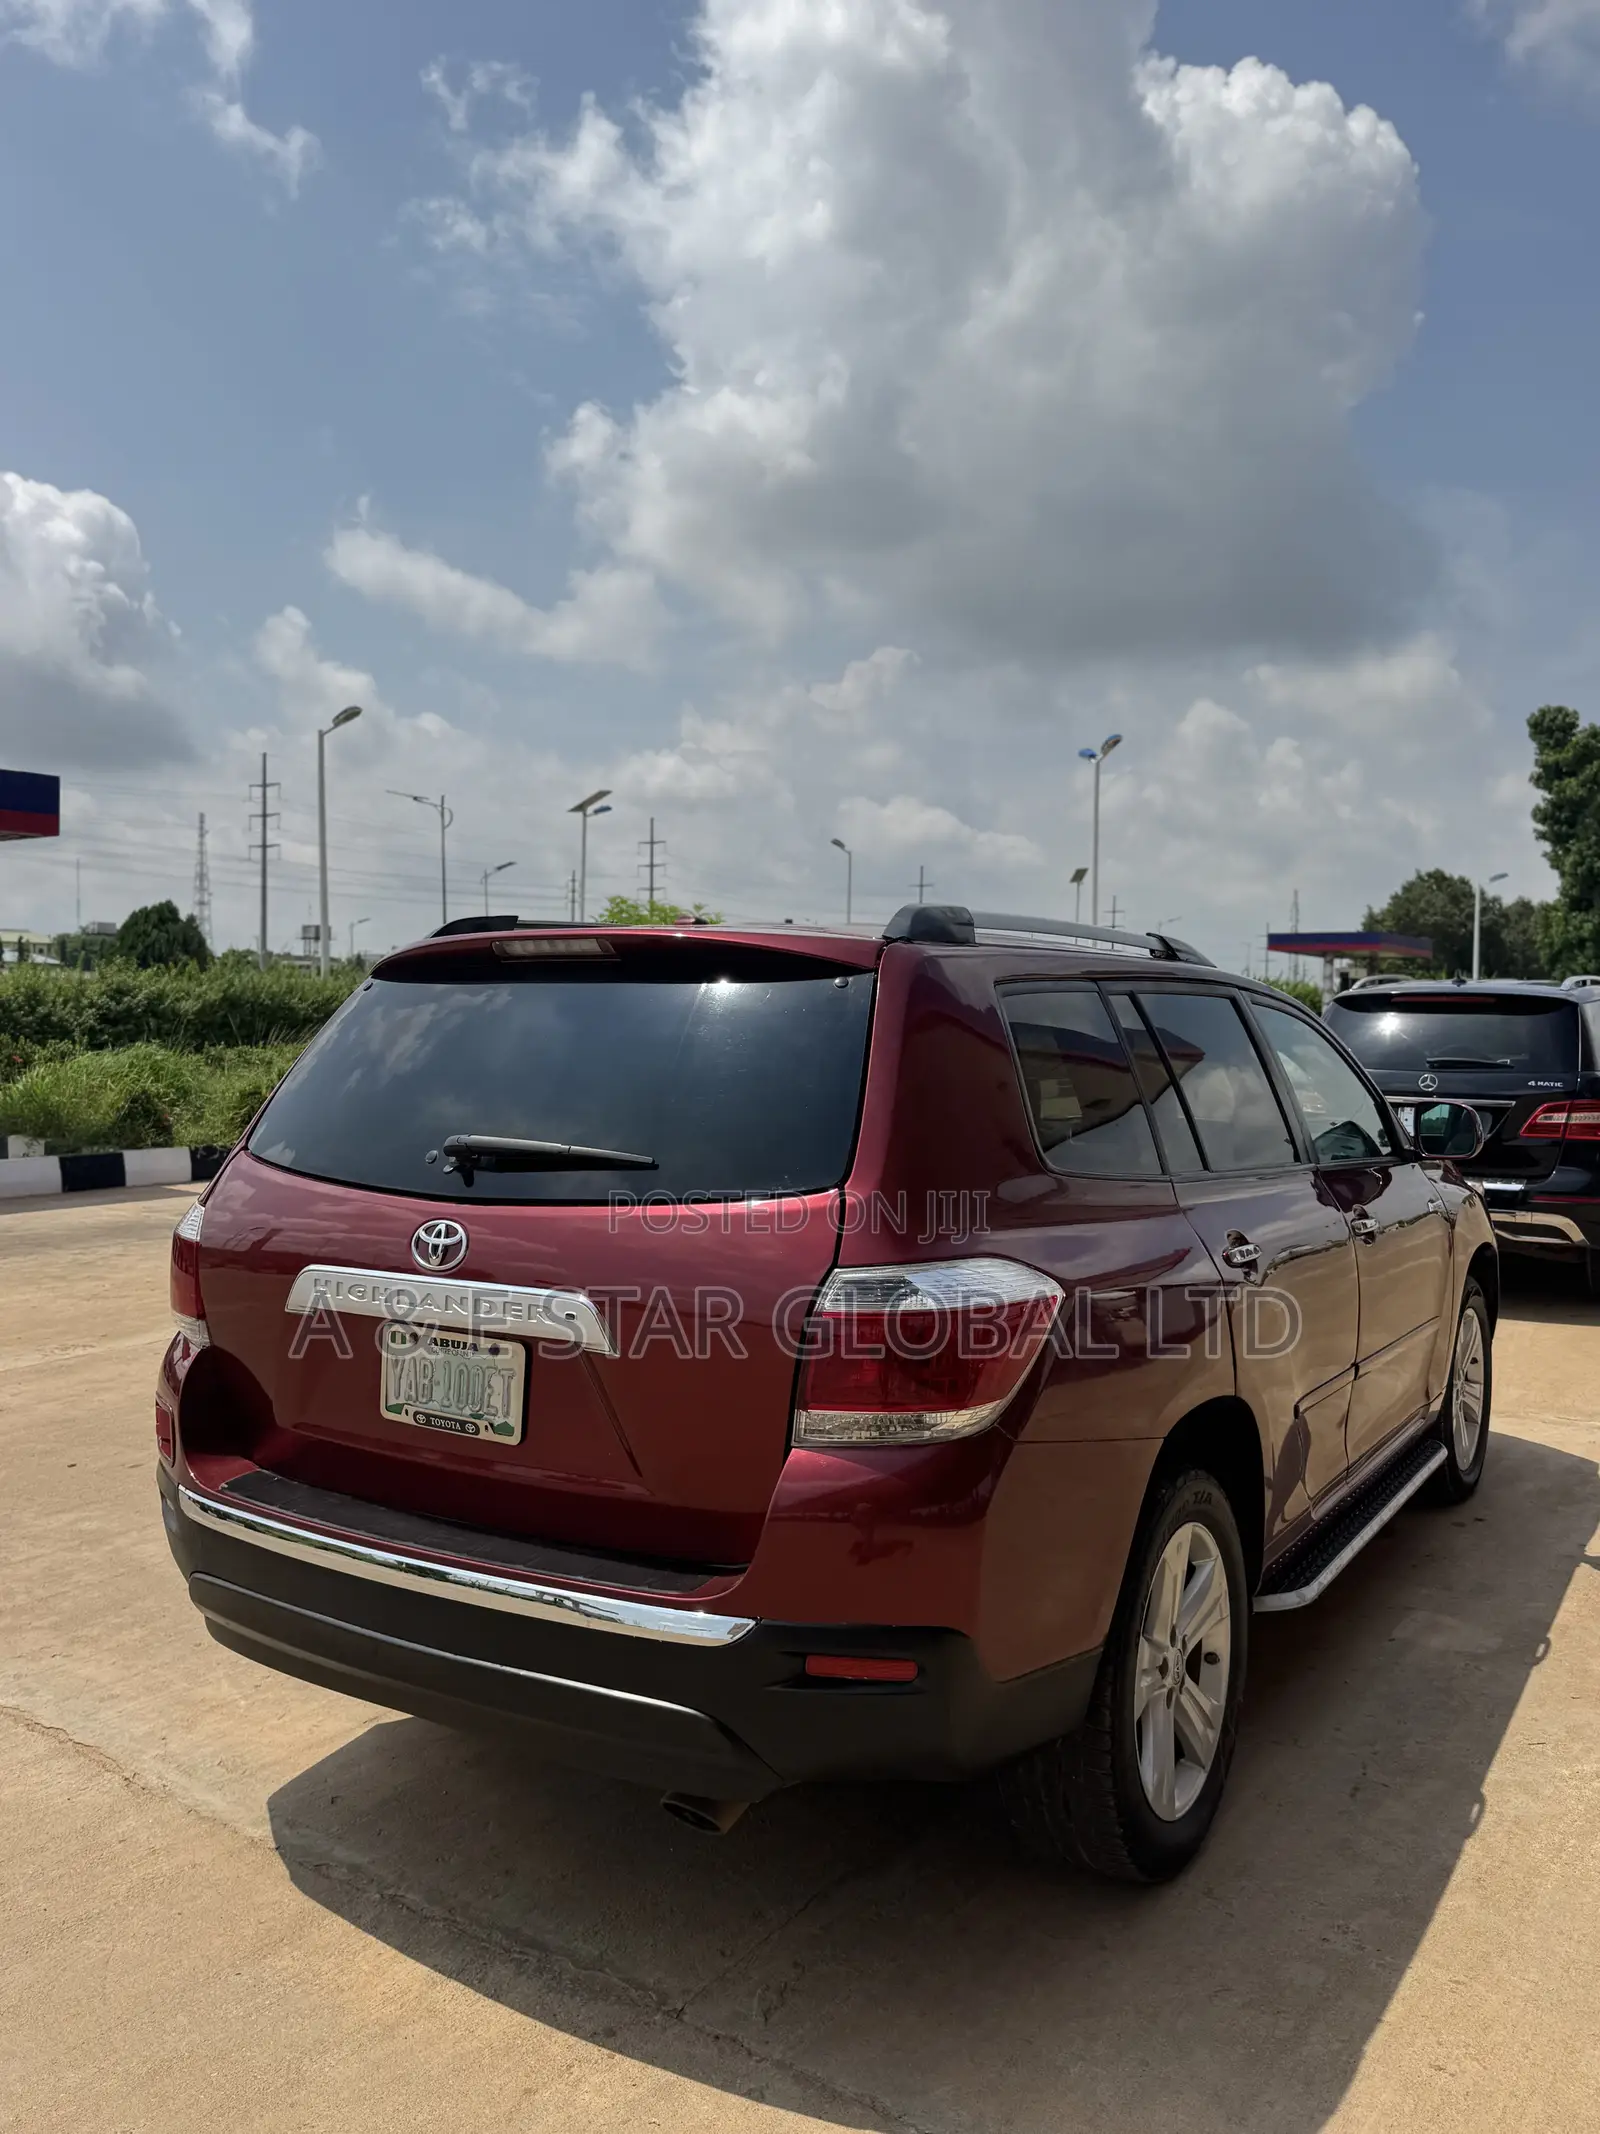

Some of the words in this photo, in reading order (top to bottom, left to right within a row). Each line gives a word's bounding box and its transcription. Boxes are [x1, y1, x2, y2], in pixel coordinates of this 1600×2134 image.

[312, 1277, 557, 1325] HIGHLANDER
[428, 1337, 479, 1352] ABUJA
[429, 1416, 462, 1431] TOYOTA
